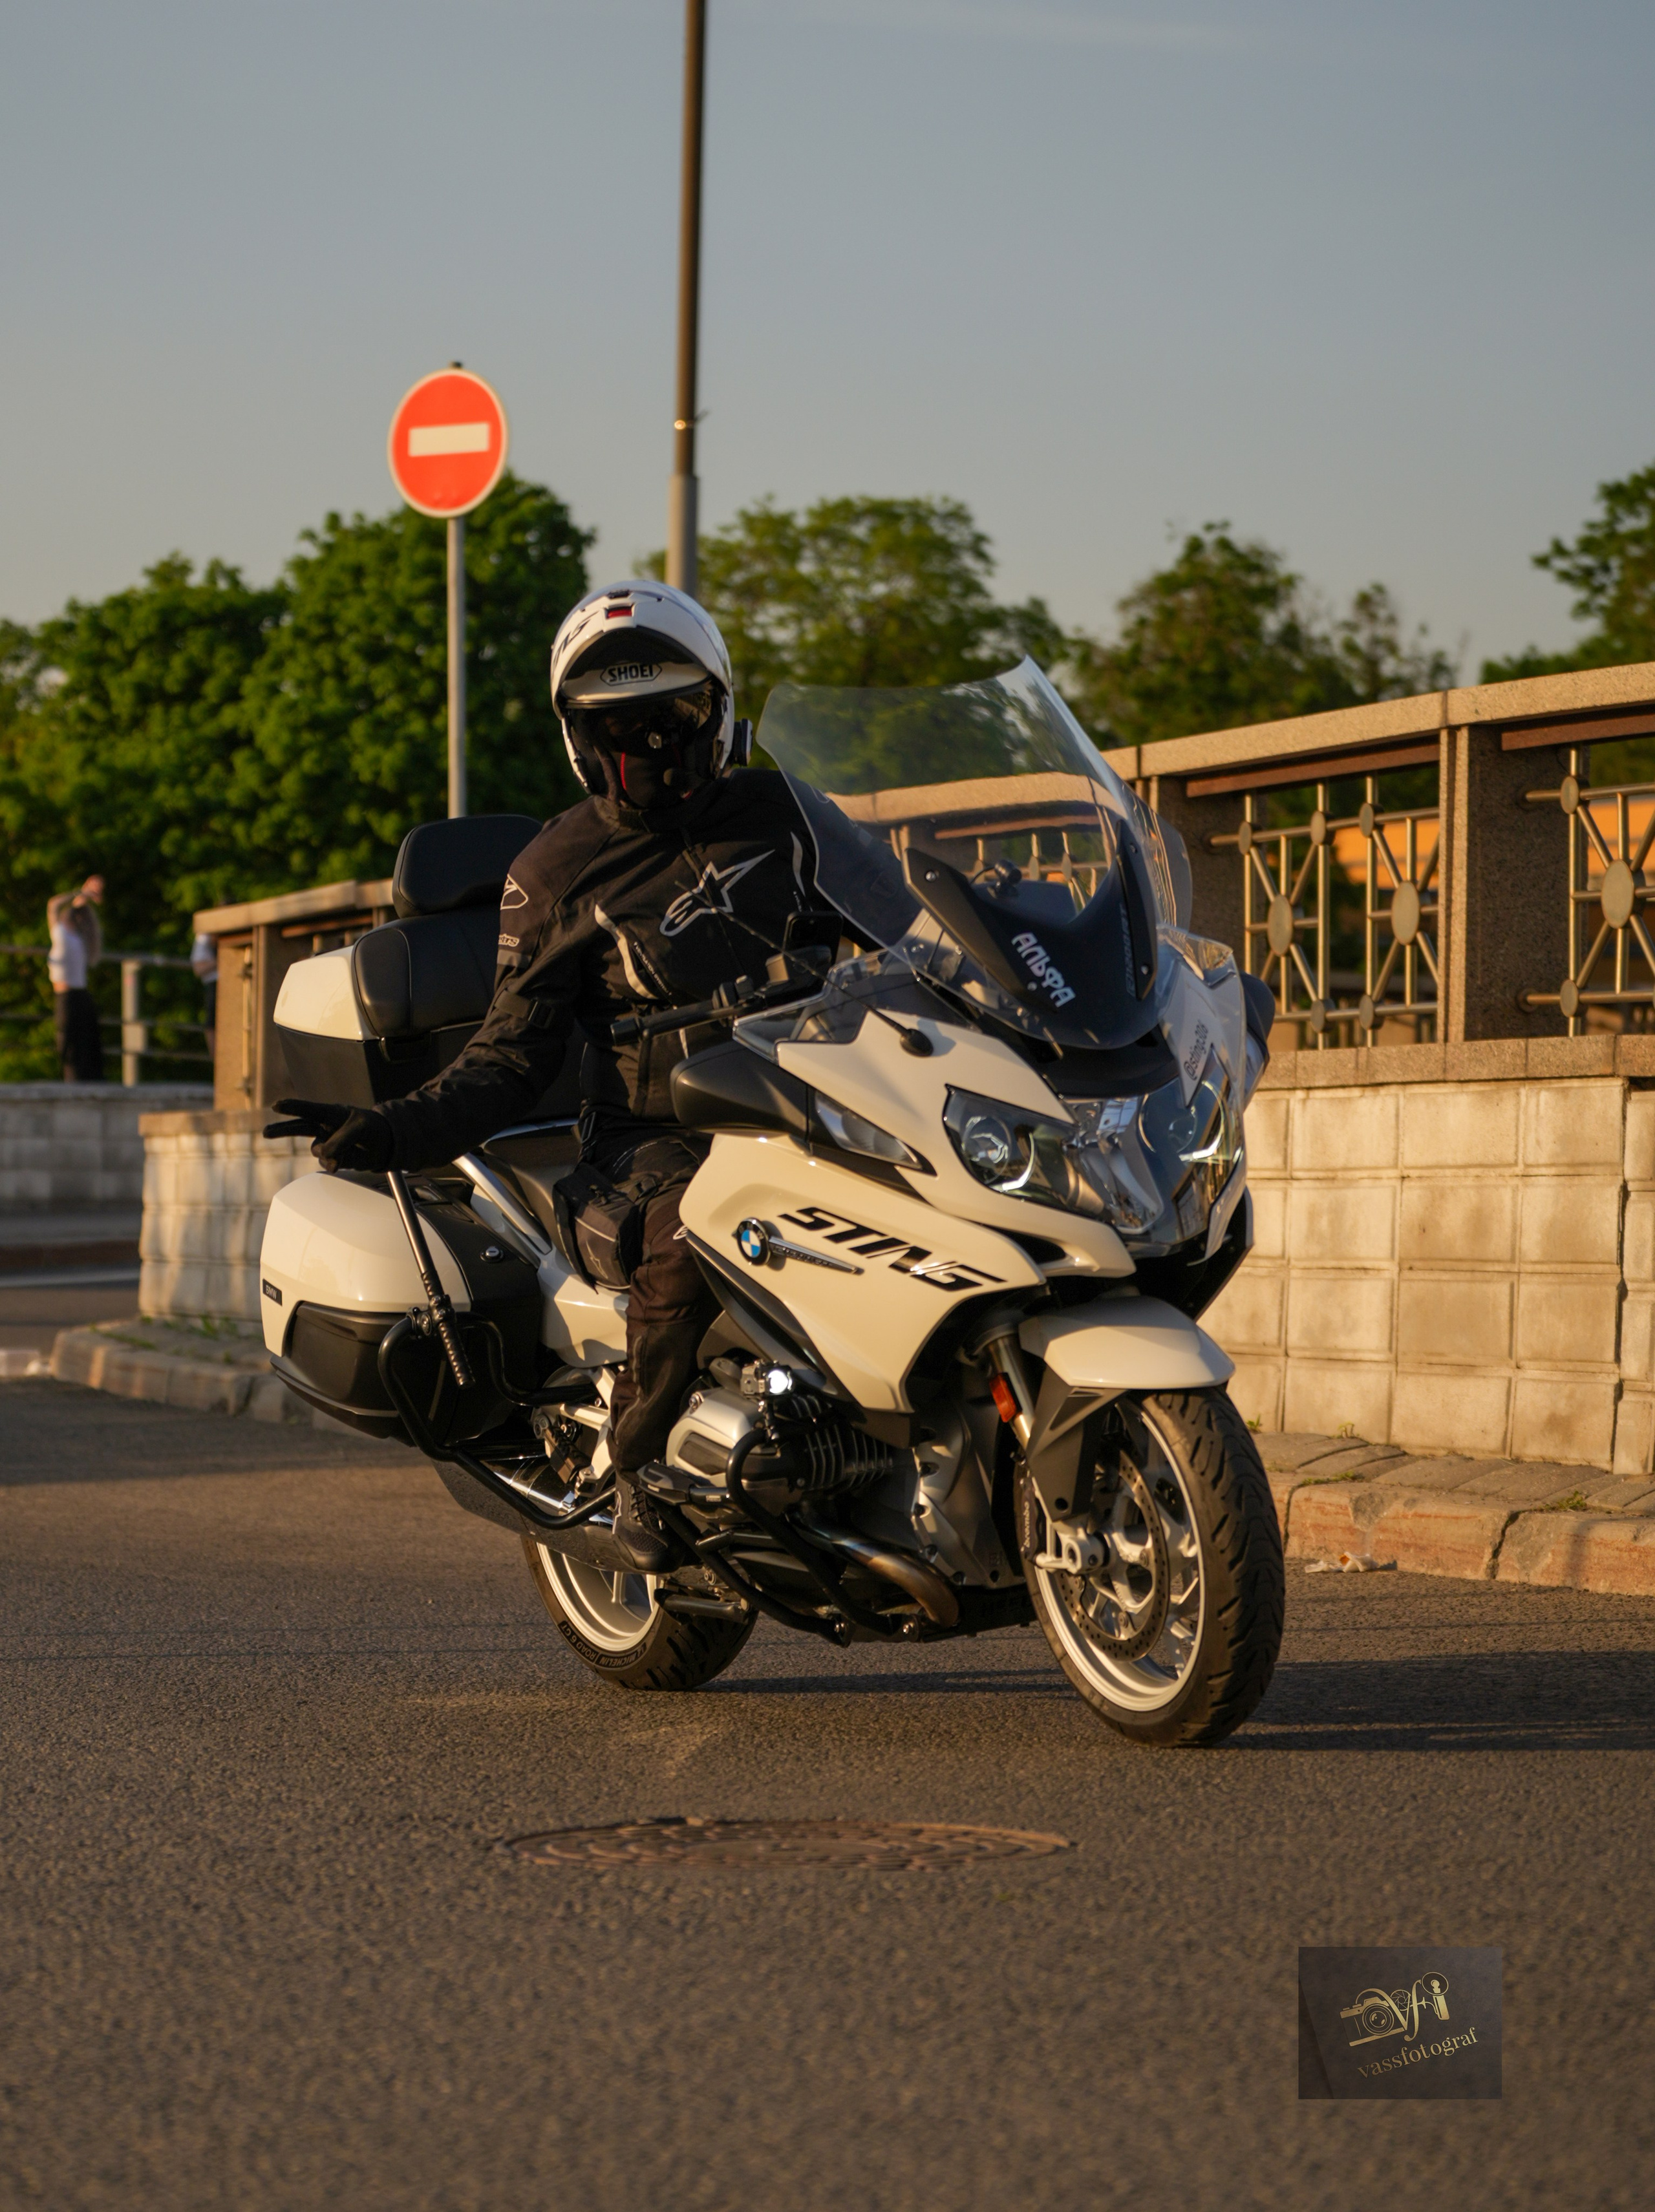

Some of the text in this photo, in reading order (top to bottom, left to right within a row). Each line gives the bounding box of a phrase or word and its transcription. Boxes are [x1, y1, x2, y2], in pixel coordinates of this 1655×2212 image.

[608, 664, 653, 682] SHOEI
[1011, 932, 1076, 1008] АЛЬФА
[776, 1207, 1008, 1292] STING
[266, 1284, 277, 1299] BMW
[561, 1624, 571, 1636] GT
[576, 1643, 597, 1660] ROAD
[599, 1653, 636, 1666] MICHELIN
